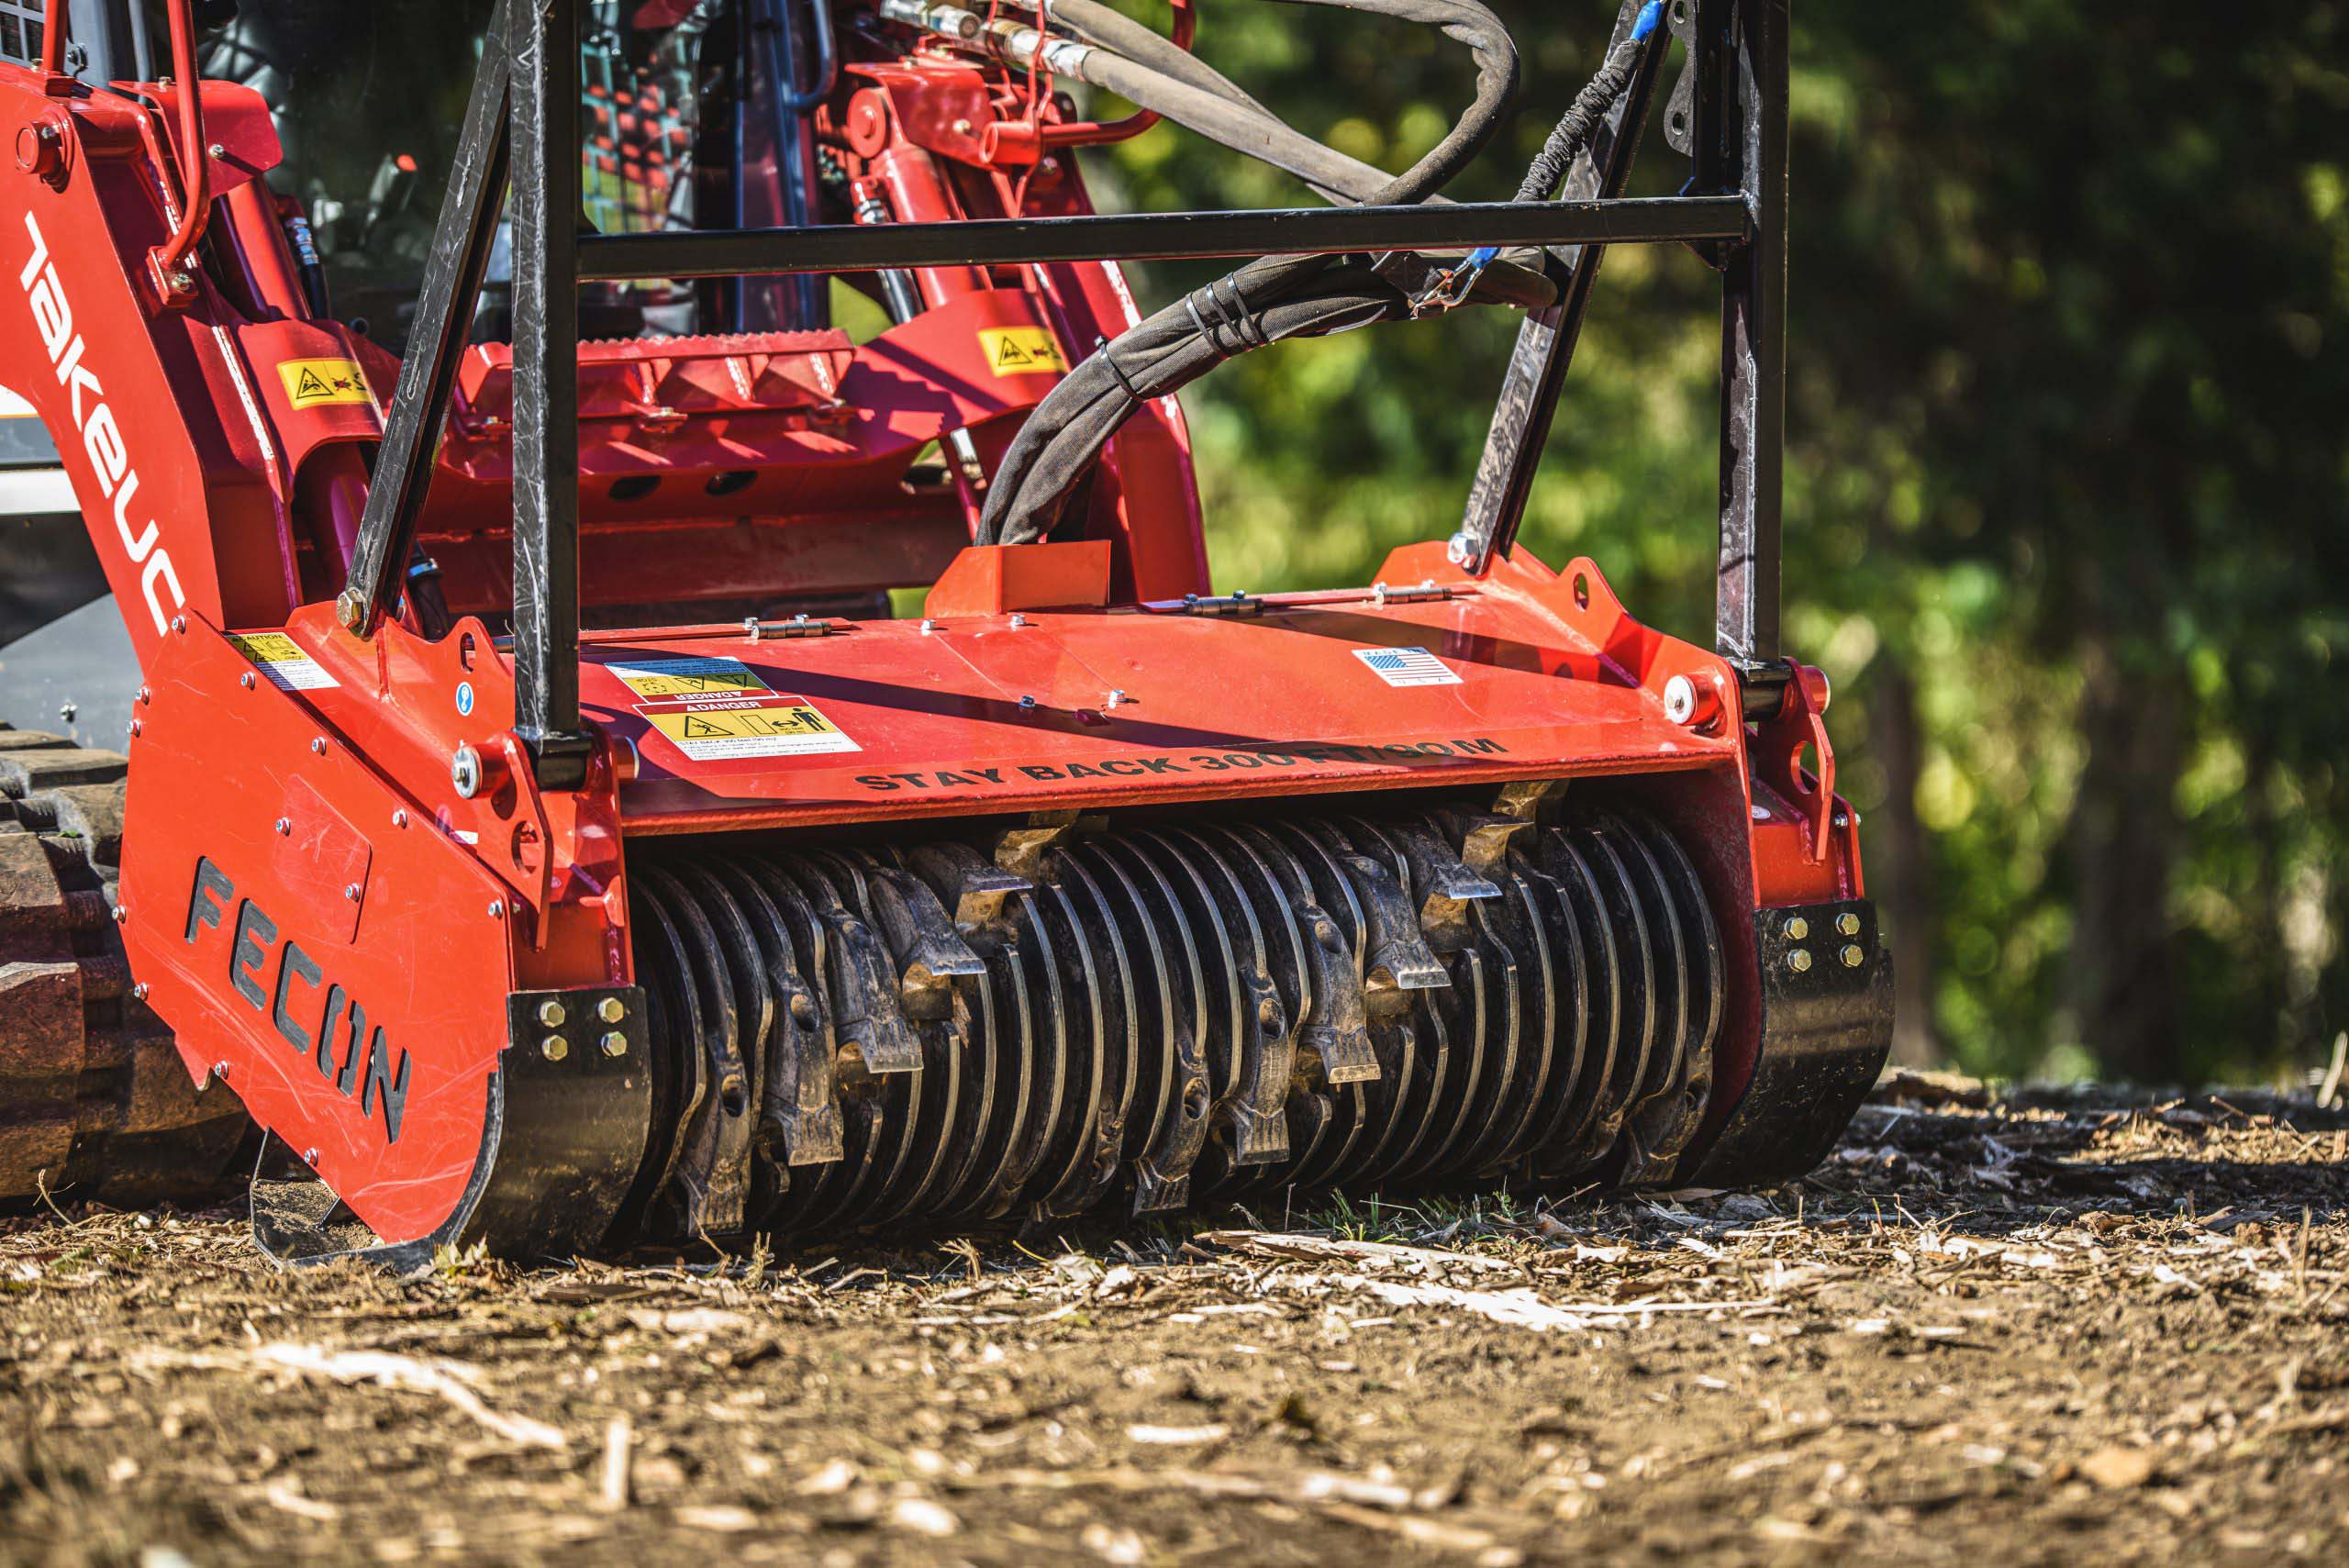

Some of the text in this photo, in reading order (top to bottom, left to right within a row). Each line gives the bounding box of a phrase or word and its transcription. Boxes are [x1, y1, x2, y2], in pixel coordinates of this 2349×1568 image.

[674, 691, 732, 700] DANGER
[696, 701, 763, 711] DANGER
[854, 769, 1006, 791] STAY
[1017, 758, 1192, 782] BACK
[1188, 752, 1297, 771] 300
[184, 855, 412, 1145] FECON
